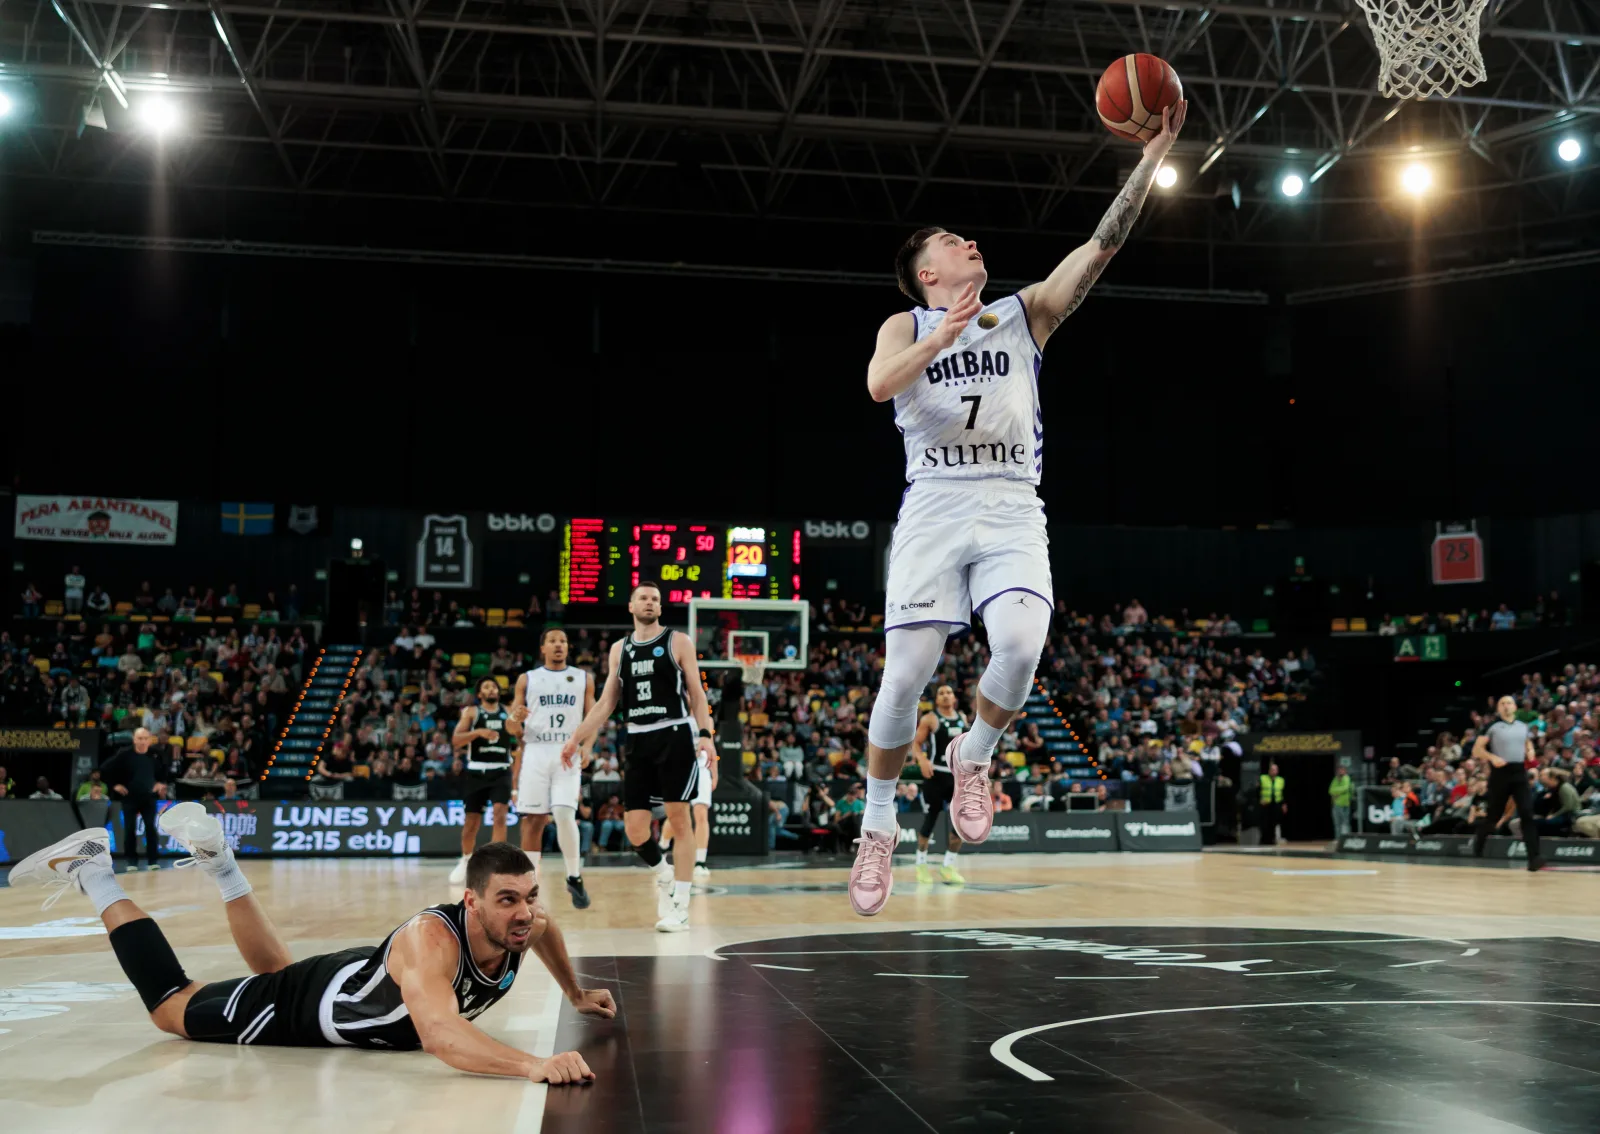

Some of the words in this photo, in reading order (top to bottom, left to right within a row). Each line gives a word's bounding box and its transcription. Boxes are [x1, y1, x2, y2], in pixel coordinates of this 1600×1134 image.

[925, 350, 1010, 385] BILBAO
[945, 377, 992, 387] BASKET
[960, 395, 982, 430] 7
[922, 442, 1025, 468] surne
[651, 533, 671, 550] 59
[695, 535, 715, 551] 50
[1445, 542, 1470, 562] 25
[734, 544, 763, 564] 20
[1398, 637, 1415, 657] A
[539, 694, 576, 706] BILBAO
[636, 680, 652, 701] 33
[550, 713, 565, 728] 19
[535, 731, 571, 743] surn
[272, 806, 369, 827] LUNES
[375, 806, 396, 827] Y
[402, 806, 519, 827] MARES
[272, 830, 341, 851] 22:15
[1555, 846, 1594, 857] NISSAN
